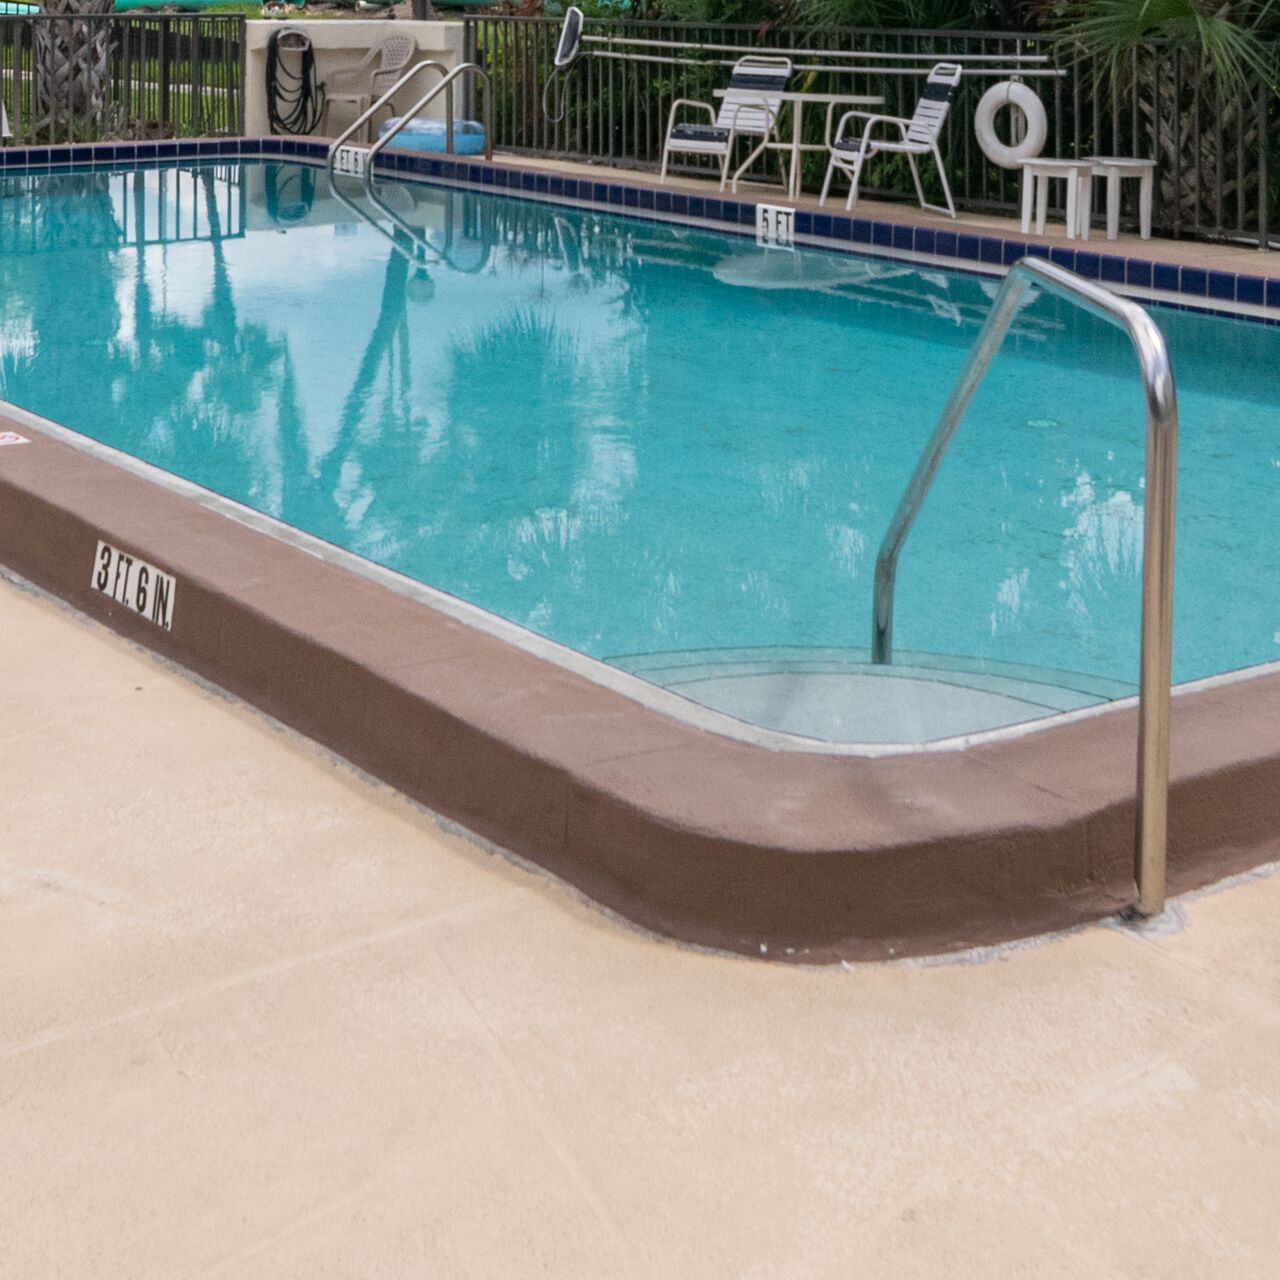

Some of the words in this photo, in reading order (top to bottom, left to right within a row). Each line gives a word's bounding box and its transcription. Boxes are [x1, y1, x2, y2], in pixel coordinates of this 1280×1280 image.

[762, 208, 769, 231] 5
[776, 210, 792, 233] FT
[97, 545, 112, 591] 3
[136, 566, 149, 613] 6
